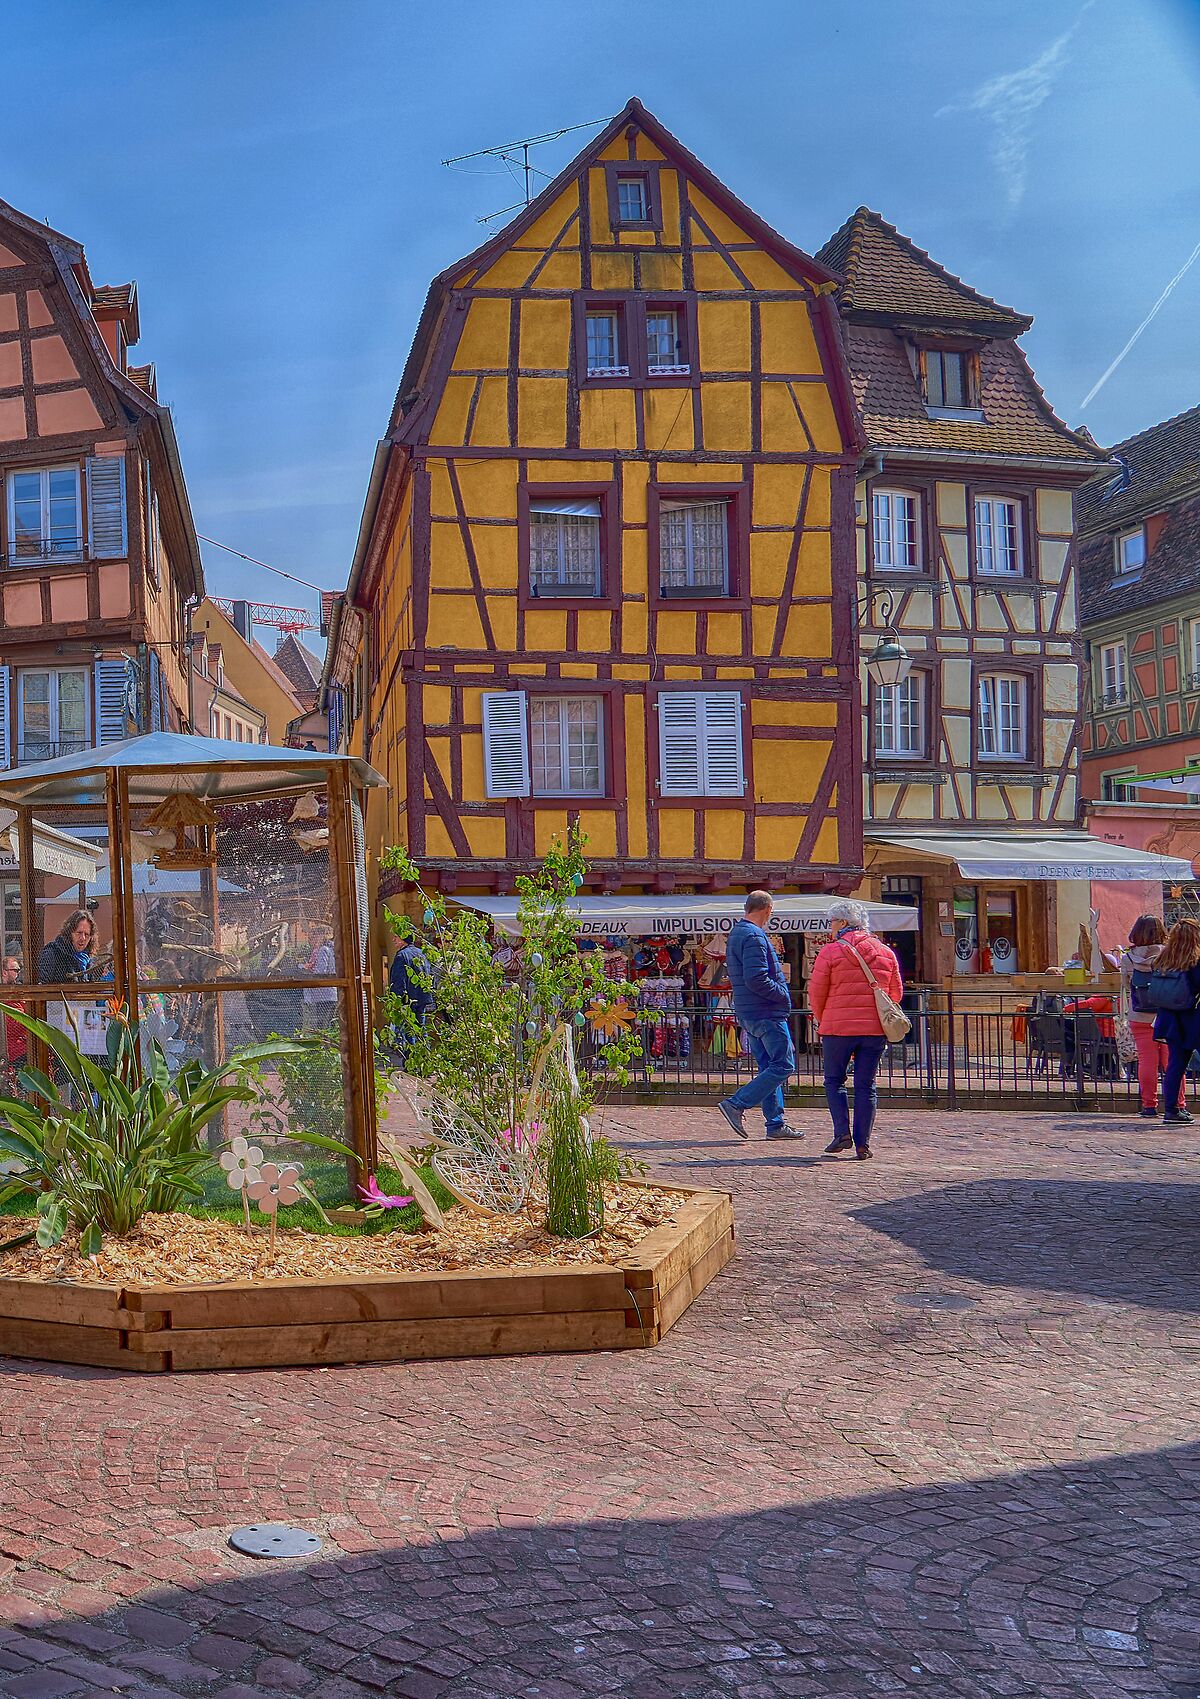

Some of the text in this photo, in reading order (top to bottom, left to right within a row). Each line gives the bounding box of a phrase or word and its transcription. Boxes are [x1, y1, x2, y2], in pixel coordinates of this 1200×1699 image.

[1039, 865, 1117, 878] DEER & BEER
[768, 917, 832, 931] SOUVEN
